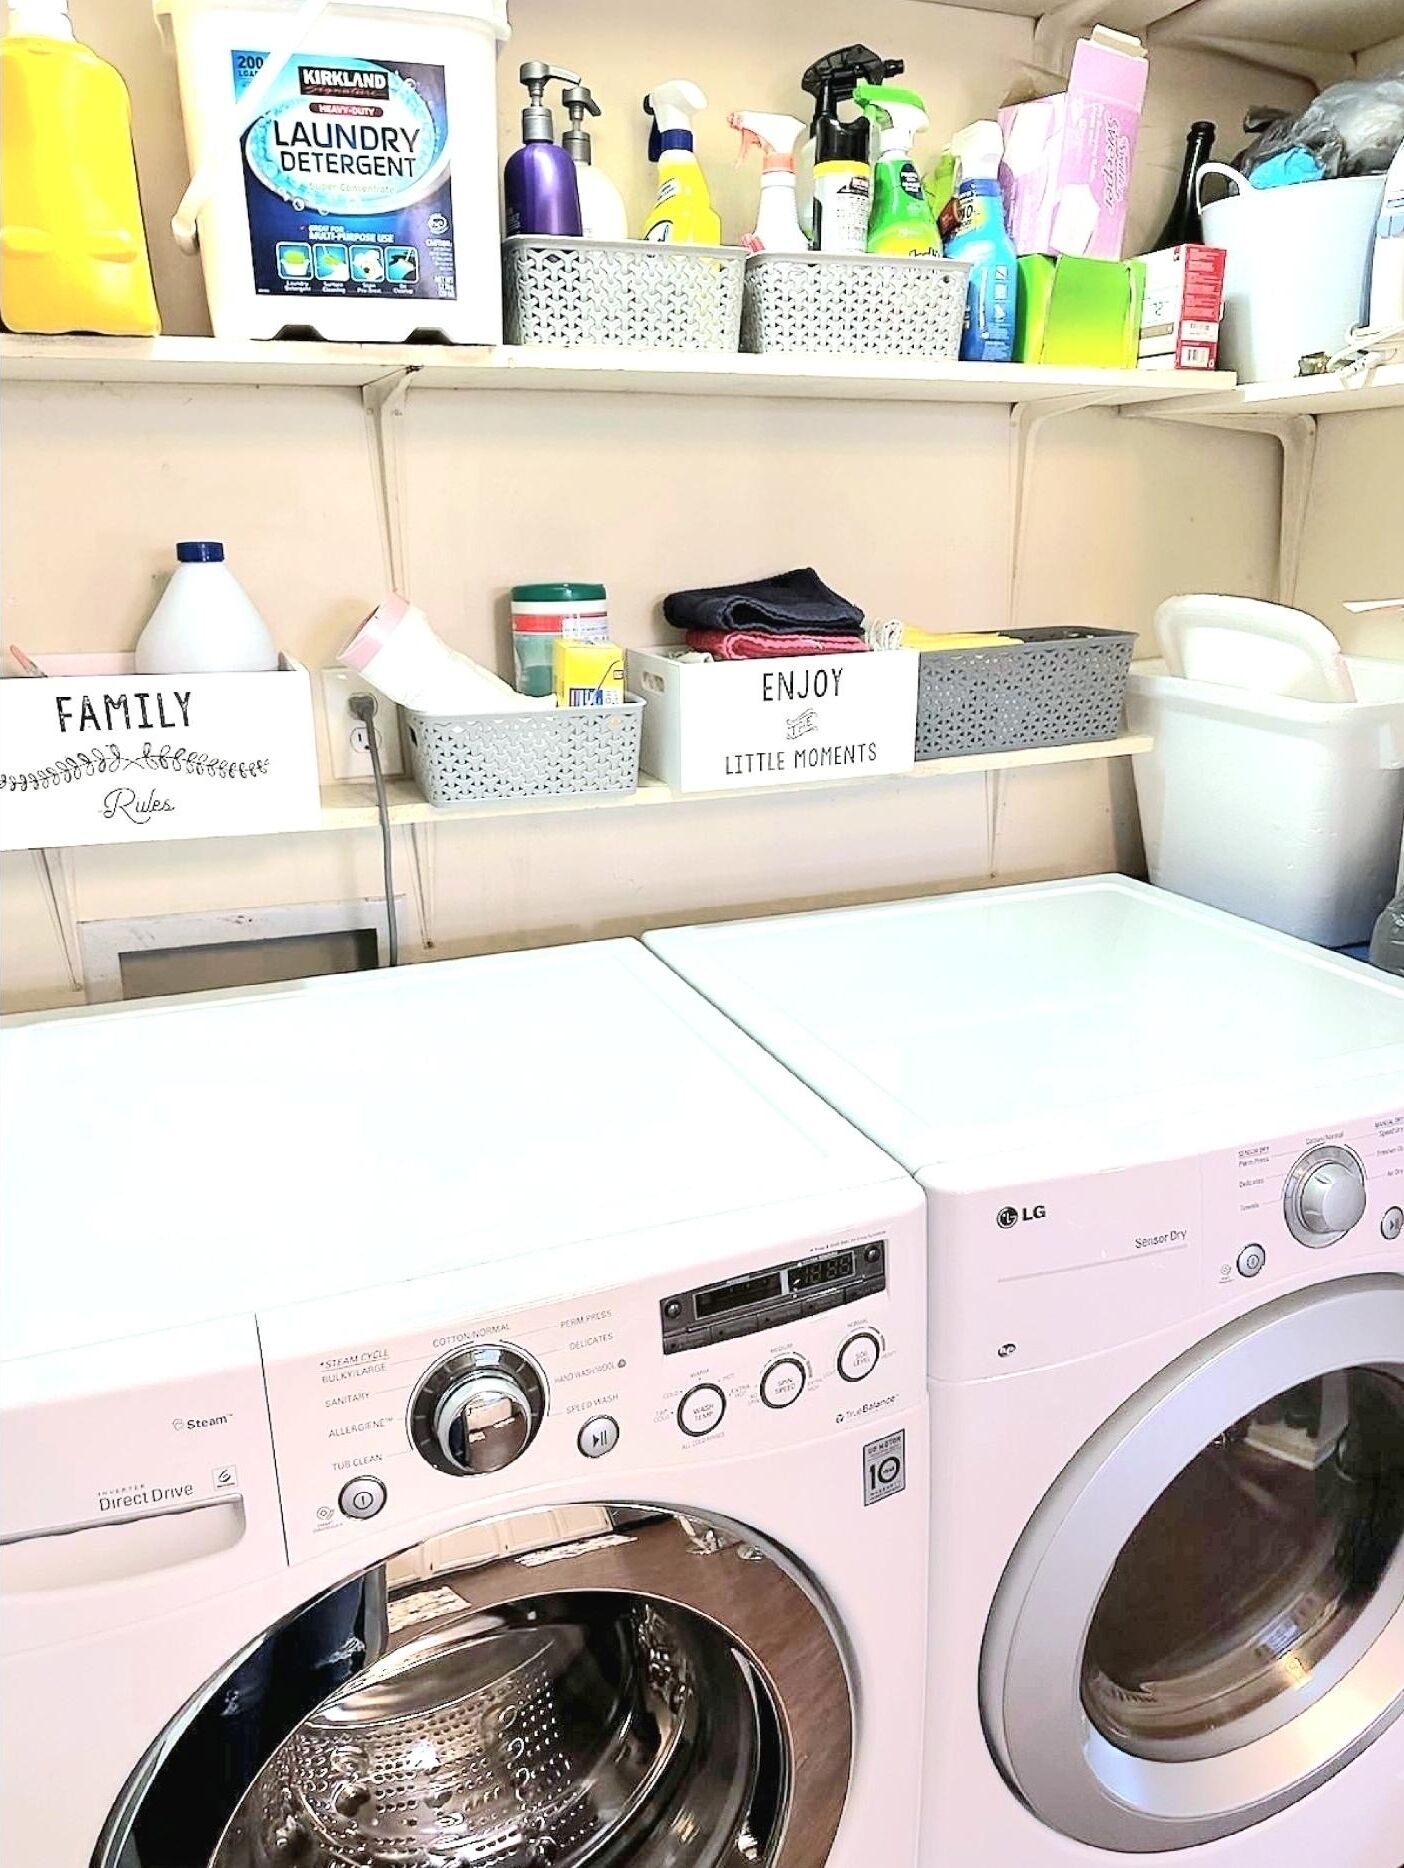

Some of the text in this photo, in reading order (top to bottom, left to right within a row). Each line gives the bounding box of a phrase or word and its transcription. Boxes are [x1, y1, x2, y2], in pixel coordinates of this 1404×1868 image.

[237, 55, 264, 70] 200
[302, 68, 387, 90] KIRKLAND
[318, 103, 376, 116] HEAVY-DUTY
[273, 119, 421, 153] LAUNDRY
[279, 150, 417, 178] DETERGENT
[1102, 116, 1119, 210] Sweeper
[308, 231, 395, 243] MULTI-PURPOSE USE
[762, 667, 844, 702] ENJOY
[55, 691, 192, 733] FAMILY
[725, 742, 877, 775] LITTLE MOMENTS
[101, 787, 176, 825] Rules
[1022, 1204, 1047, 1222] LG
[1135, 1229, 1187, 1249] Sensor Dry
[560, 1309, 613, 1329] PERM PRESS
[569, 1331, 614, 1351] DELICATES
[360, 1348, 389, 1361] CYCLE
[324, 1392, 369, 1408] SANITARY
[566, 1393, 619, 1415] SPEED WASH
[332, 1454, 383, 1472] TUB CLEAN
[869, 1456, 901, 1490] 10
[99, 1484, 194, 1512] Direct Drive
